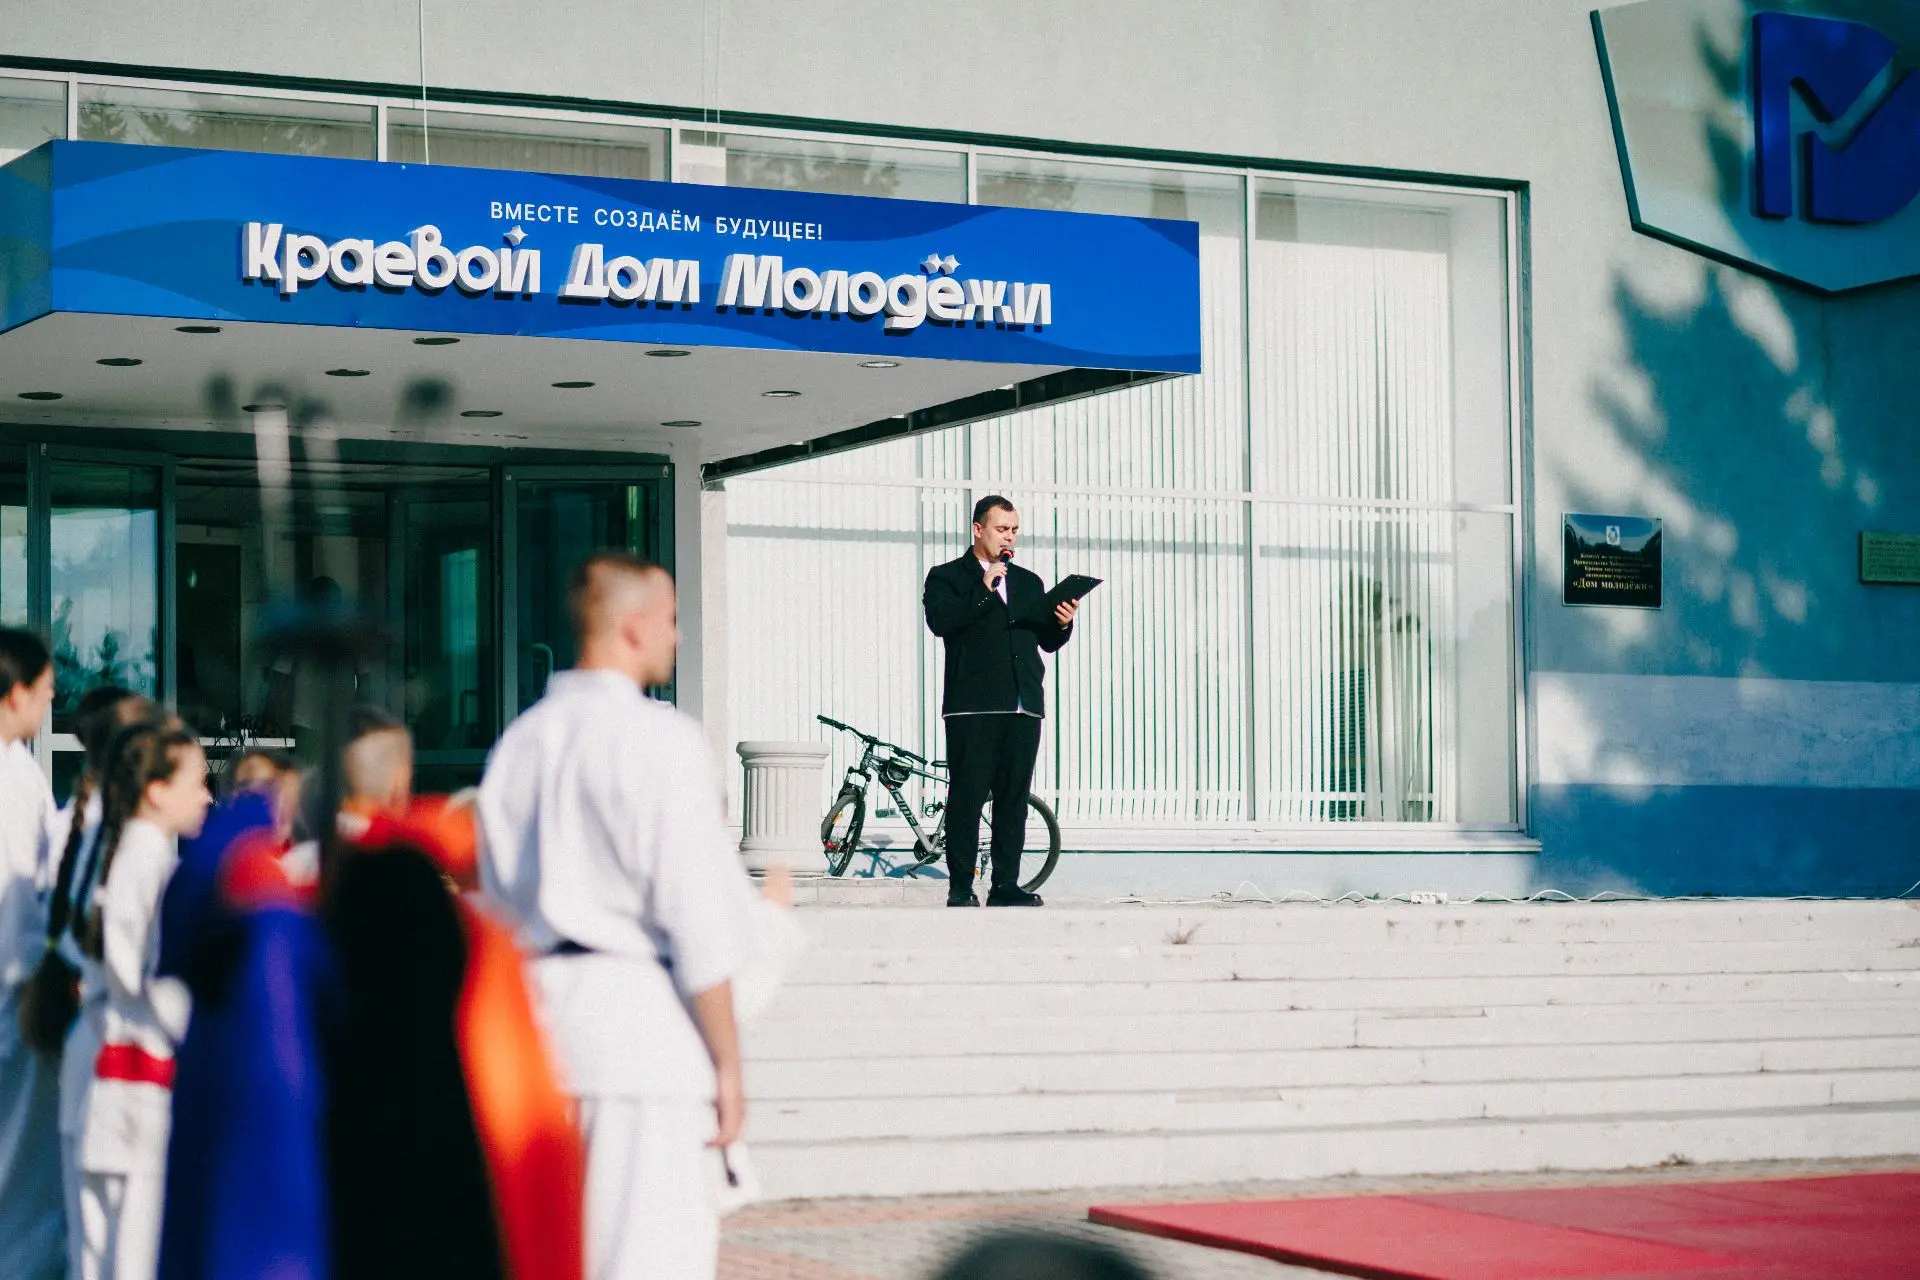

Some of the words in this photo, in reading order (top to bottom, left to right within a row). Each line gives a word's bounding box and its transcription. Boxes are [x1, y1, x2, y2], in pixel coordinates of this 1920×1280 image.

[490, 201, 579, 224] ВМЕСТЕ
[594, 208, 701, 232] СОЗДАЁМ
[716, 217, 822, 241] БУДУЩЕЕ!
[242, 221, 541, 294] Краевой
[558, 243, 700, 303] Дом
[717, 252, 1052, 329] Молодёжи
